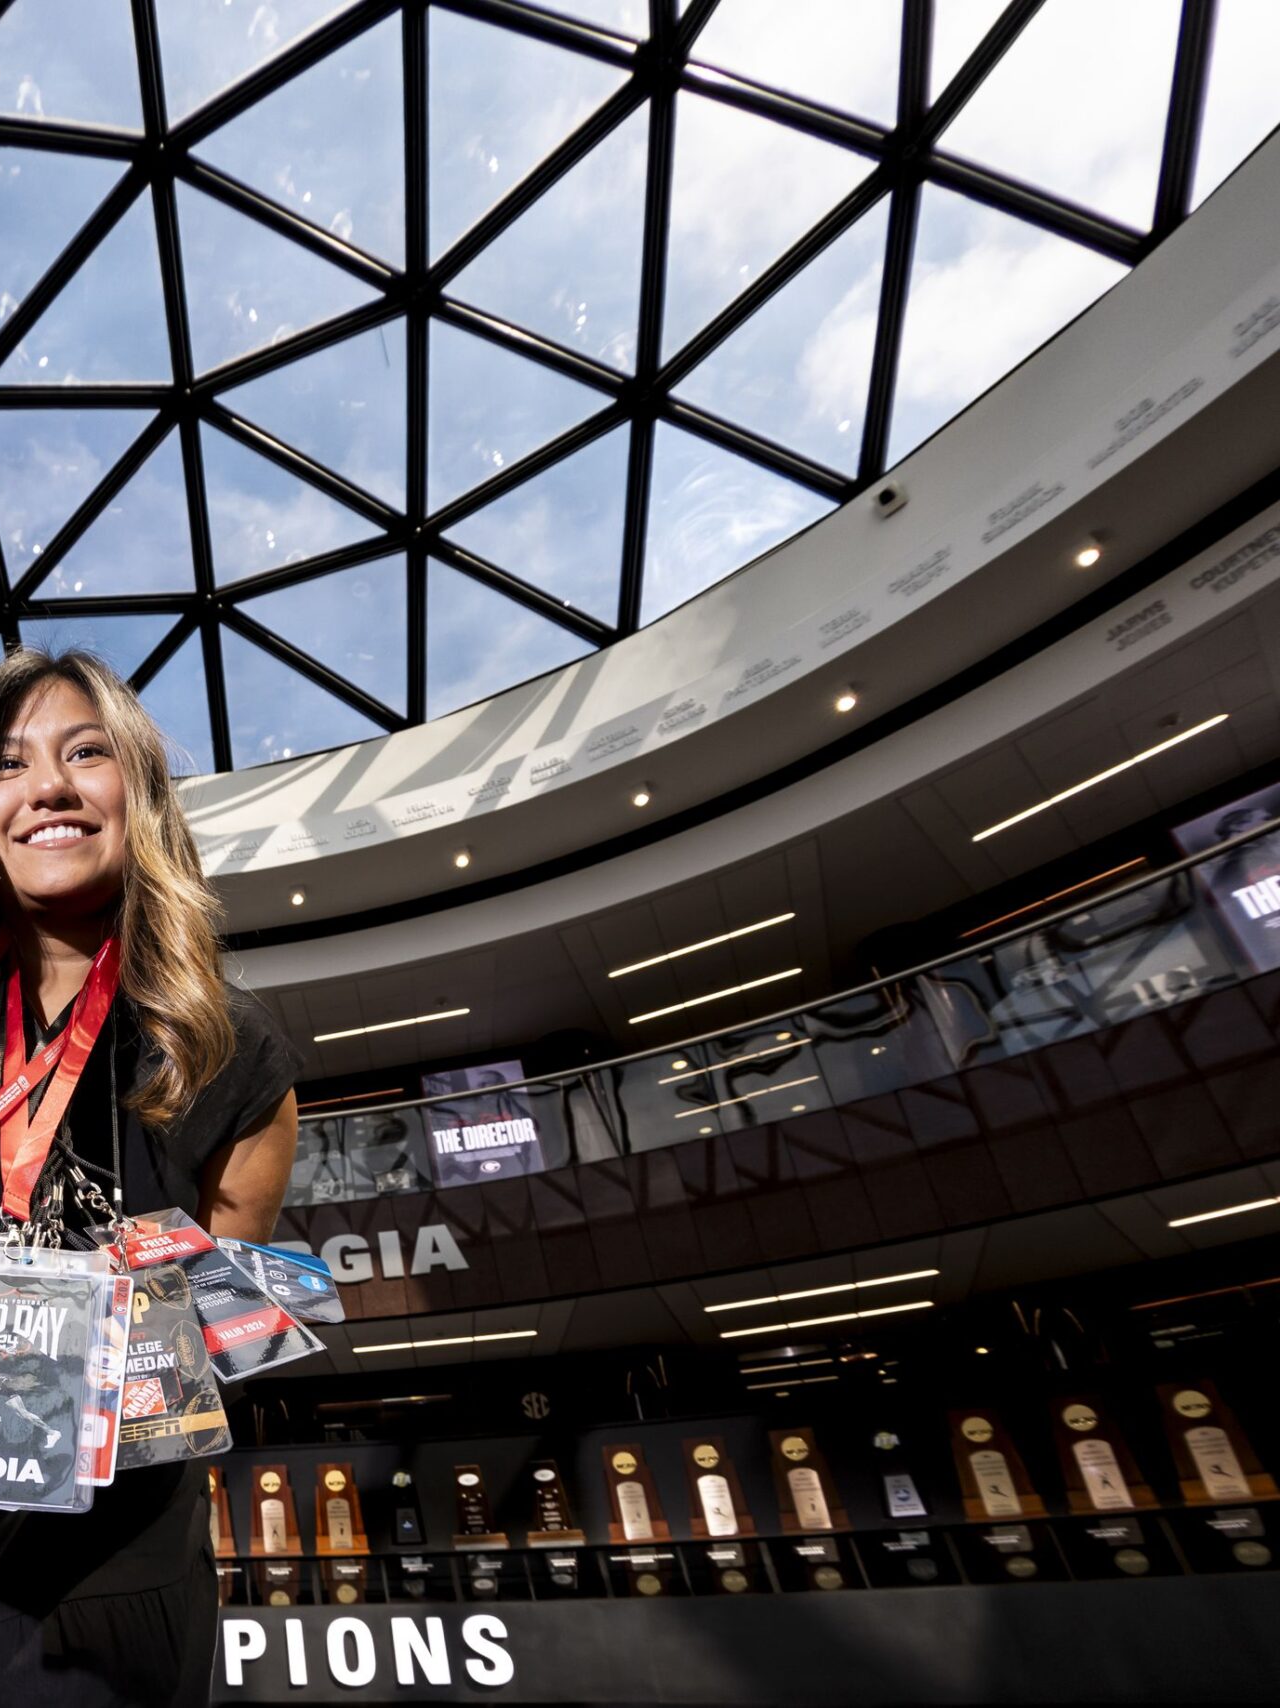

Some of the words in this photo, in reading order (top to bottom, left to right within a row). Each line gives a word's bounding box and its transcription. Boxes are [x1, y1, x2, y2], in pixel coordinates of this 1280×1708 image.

[432, 1127, 464, 1154] THE
[461, 1117, 538, 1151] DIRECTOR
[134, 1241, 195, 1263] CREDENTIAL
[139, 1235, 174, 1250] PRESS
[268, 1224, 470, 1284] GIA
[12, 1303, 69, 1362] DAY
[218, 1327, 244, 1343] VALID
[244, 1319, 267, 1336] 2024
[123, 1380, 160, 1417] HOME
[120, 1418, 181, 1442] ESPN
[222, 1613, 516, 1687] PIONS
